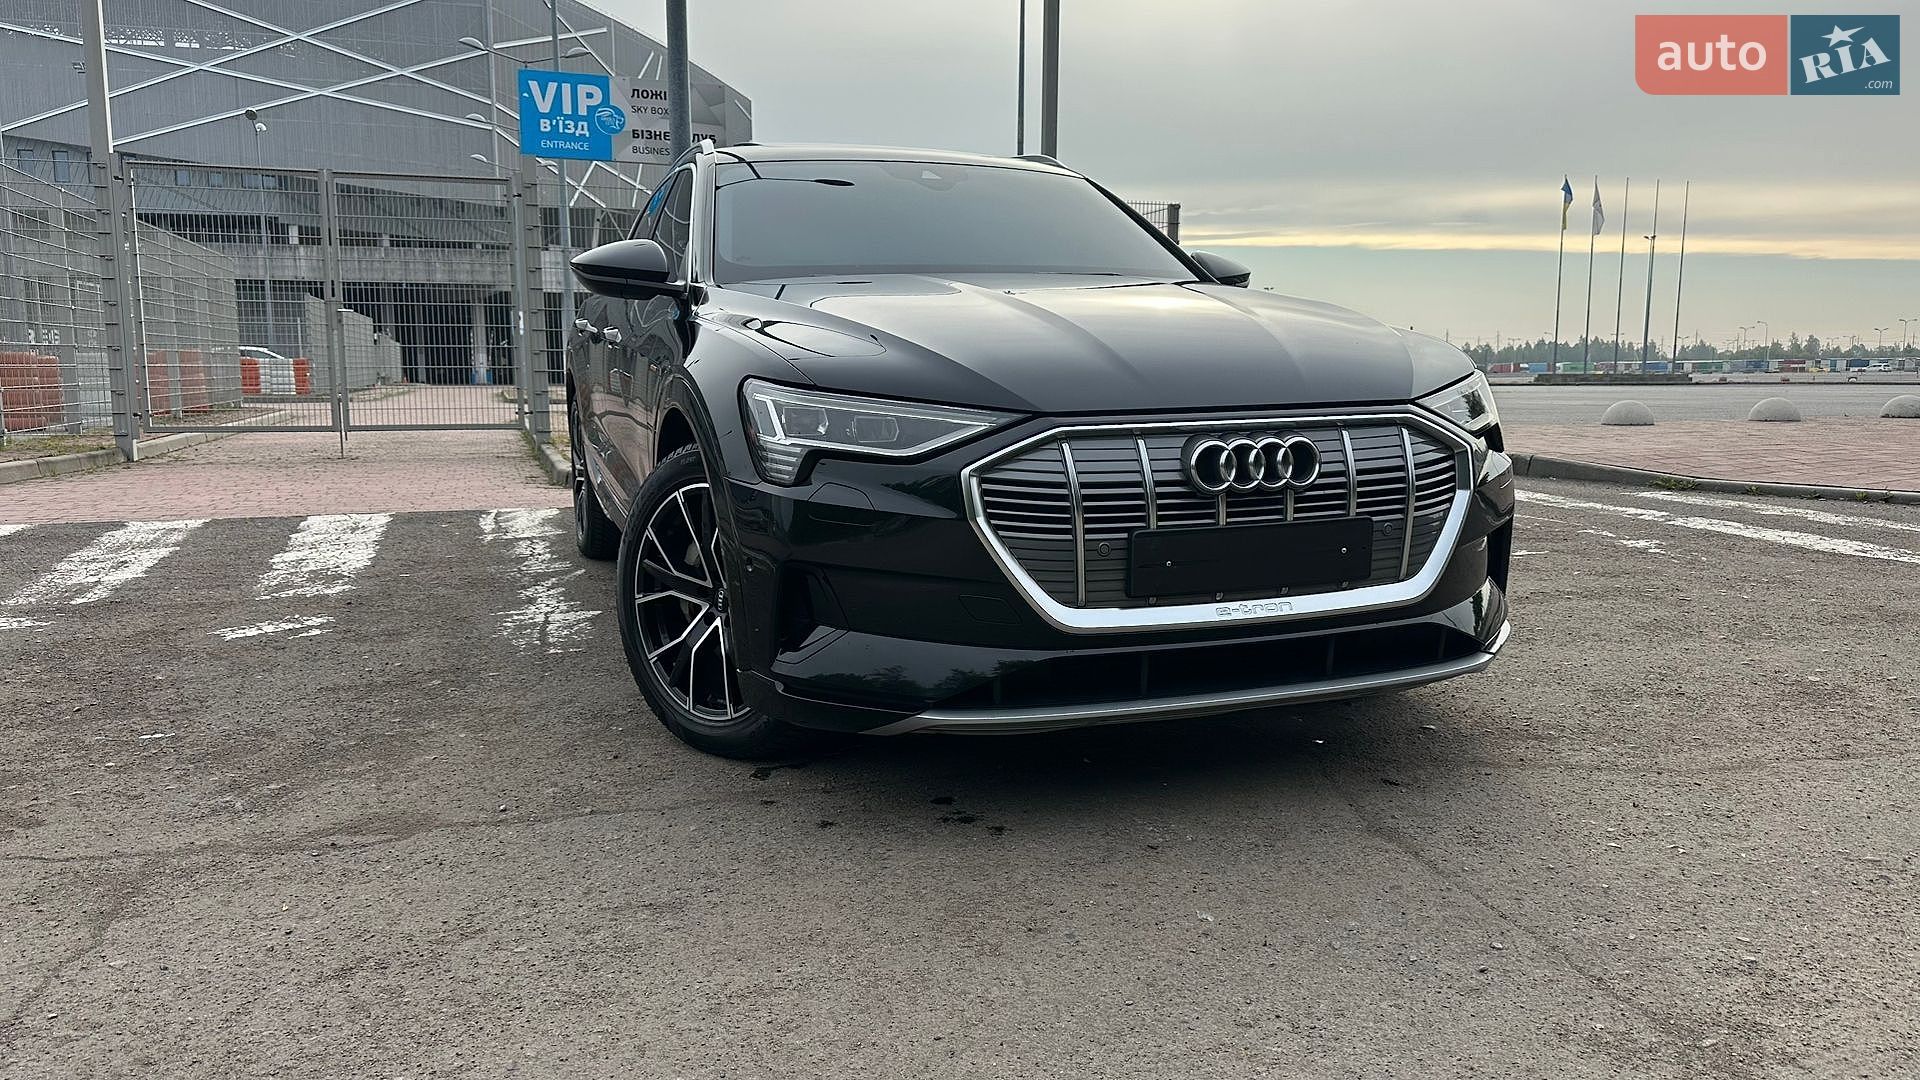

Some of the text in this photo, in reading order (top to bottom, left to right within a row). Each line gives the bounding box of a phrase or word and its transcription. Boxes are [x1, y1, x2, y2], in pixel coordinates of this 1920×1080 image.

[528, 80, 603, 116] VIP
[631, 88, 667, 101] ЛОЖІ
[631, 105, 669, 116] SKY BOX
[632, 129, 671, 141] БІЗНЕ
[541, 140, 590, 151] ENTRANCE
[632, 145, 670, 156] BUSINES
[1215, 601, 1293, 617] e-tron
